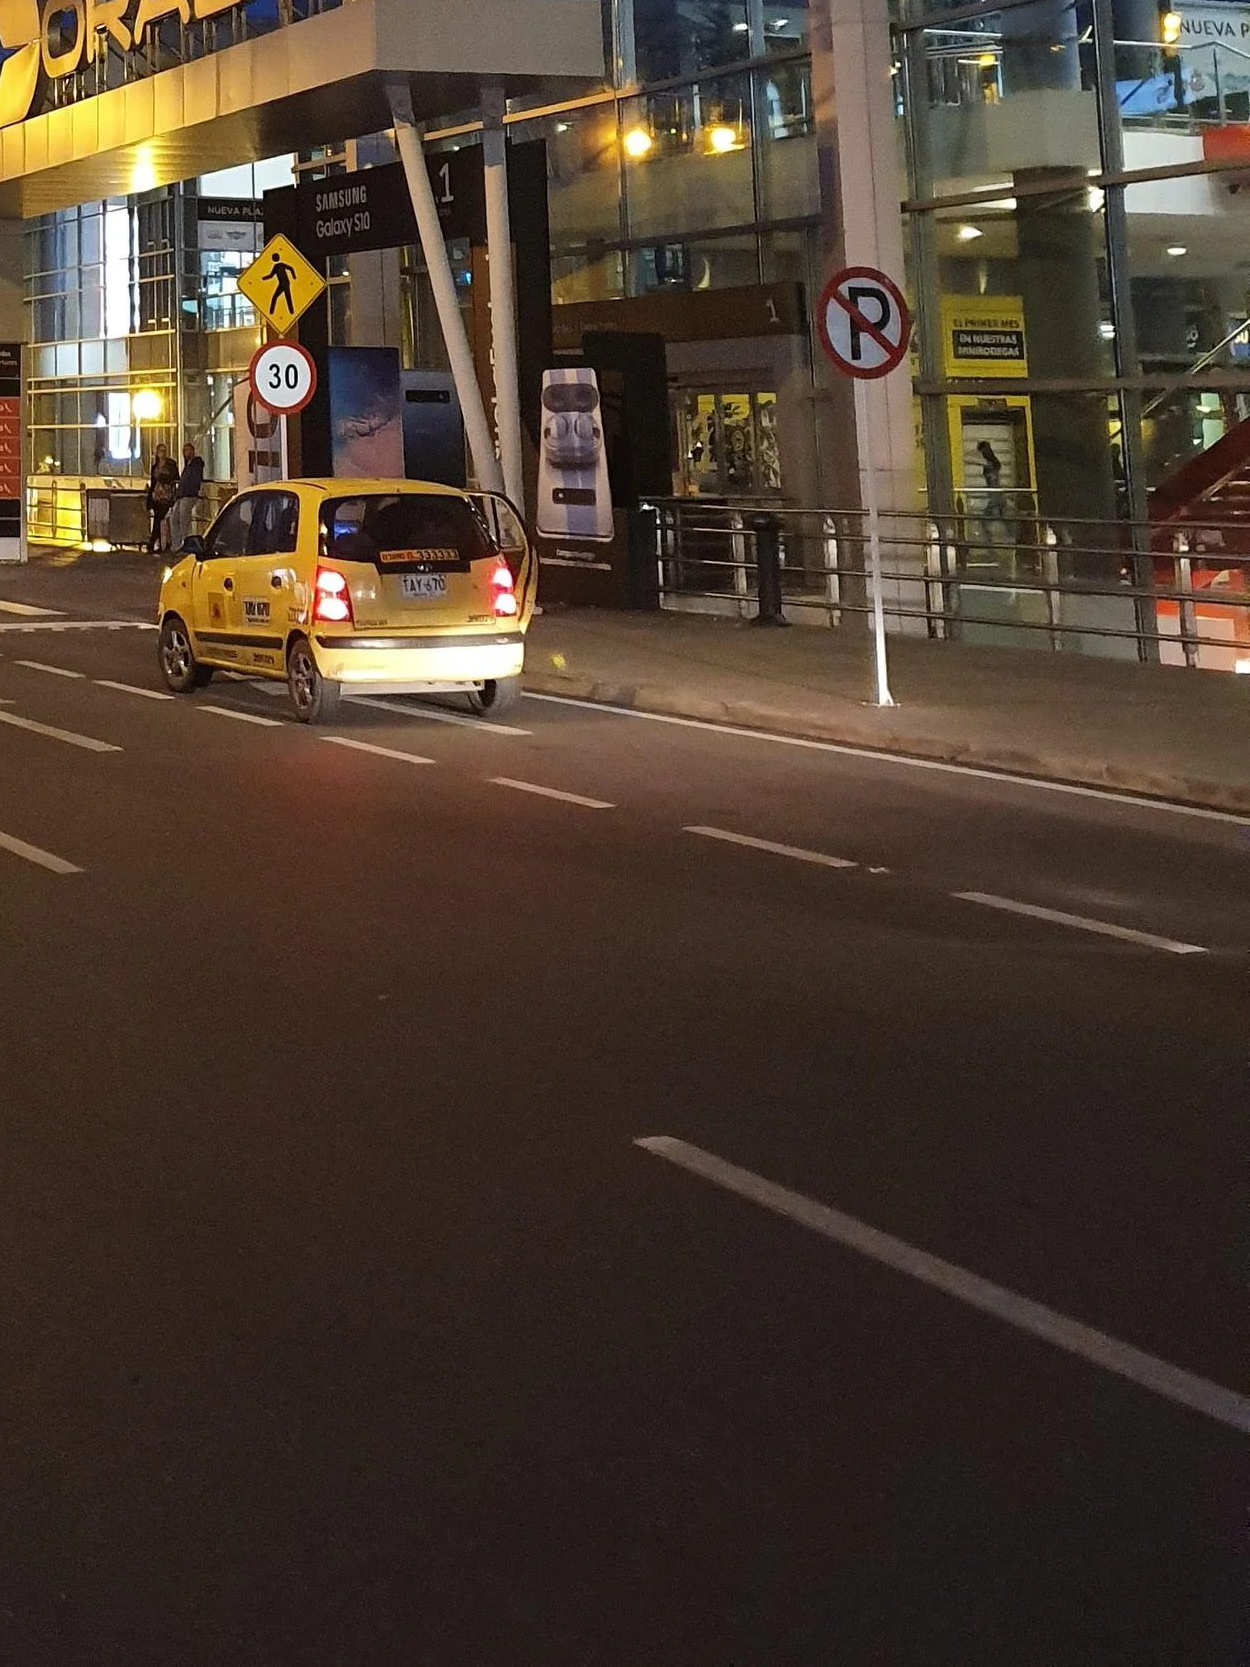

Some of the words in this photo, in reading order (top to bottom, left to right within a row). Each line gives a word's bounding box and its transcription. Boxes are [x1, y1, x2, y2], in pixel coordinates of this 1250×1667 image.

[1180, 19, 1236, 36] NUEVA
[207, 205, 240, 215] NUEVA
[315, 185, 367, 212] SAMSUNG
[316, 218, 353, 238] Galaxy
[354, 211, 370, 232] S10
[268, 363, 299, 390] 30
